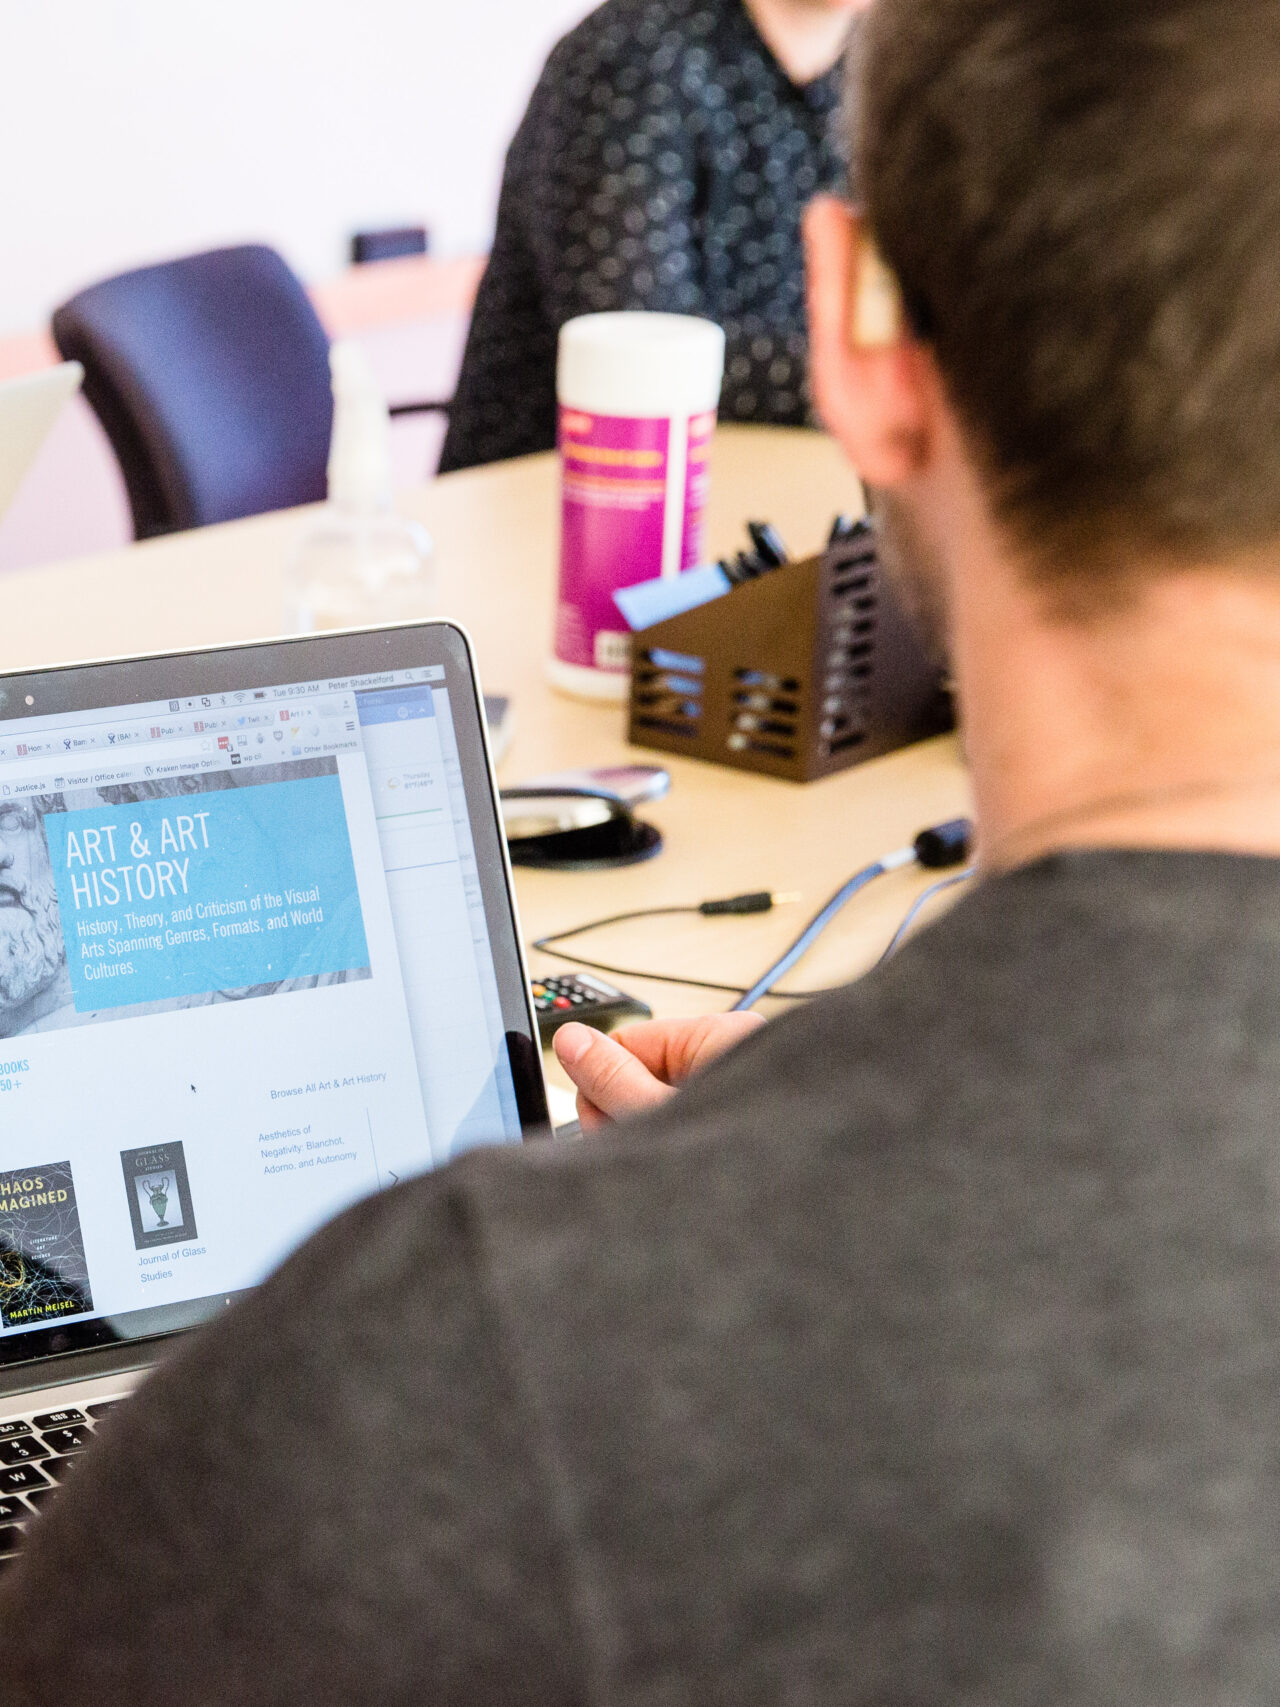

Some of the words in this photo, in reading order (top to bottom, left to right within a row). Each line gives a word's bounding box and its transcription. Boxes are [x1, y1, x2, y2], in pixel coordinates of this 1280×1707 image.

[273, 689, 286, 697] Tue
[288, 687, 306, 696] 9:30
[308, 684, 320, 692] AM
[328, 681, 348, 690] Peter
[350, 675, 394, 688] Shackelford
[156, 764, 178, 773] Kraken
[180, 762, 200, 771] Image
[14, 782, 46, 793] Justice.js
[68, 776, 88, 785] Visitor
[94, 773, 114, 782] Office
[66, 825, 117, 868] ART
[130, 822, 151, 858] &
[160, 812, 210, 854] ART
[70, 857, 190, 910] HISTORY
[171, 904, 193, 923] and
[196, 899, 248, 920] Criticism
[250, 894, 262, 912] of
[264, 892, 282, 909] the
[284, 885, 320, 906] Visual
[81, 942, 105, 960] Arts
[108, 933, 164, 958] Spanning
[166, 928, 210, 946] Genres,
[212, 918, 264, 939] Formats,
[266, 912, 288, 931] and
[290, 906, 324, 926] World
[84, 961, 138, 981] Cultures.
[270, 1086, 304, 1100] Browse
[306, 1084, 316, 1094] All
[318, 1080, 331, 1091] Art
[333, 1079, 340, 1088] &
[342, 1076, 355, 1088] Art
[356, 1072, 387, 1084] History
[258, 1128, 302, 1143] Aesthetics
[303, 1125, 311, 1135] of
[136, 1153, 170, 1167] GLASS
[298, 1158, 314, 1169] and
[316, 1152, 358, 1166] Autonomy
[138, 1253, 170, 1267] Journal
[172, 1250, 180, 1260] of
[181, 1246, 207, 1258] Glass
[140, 1269, 173, 1284] Studies
[10, 1306, 42, 1320] MARTIN
[44, 1300, 74, 1313] MEISEL
[8, 1472, 27, 1482] W
[0, 1505, 12, 1514] A
